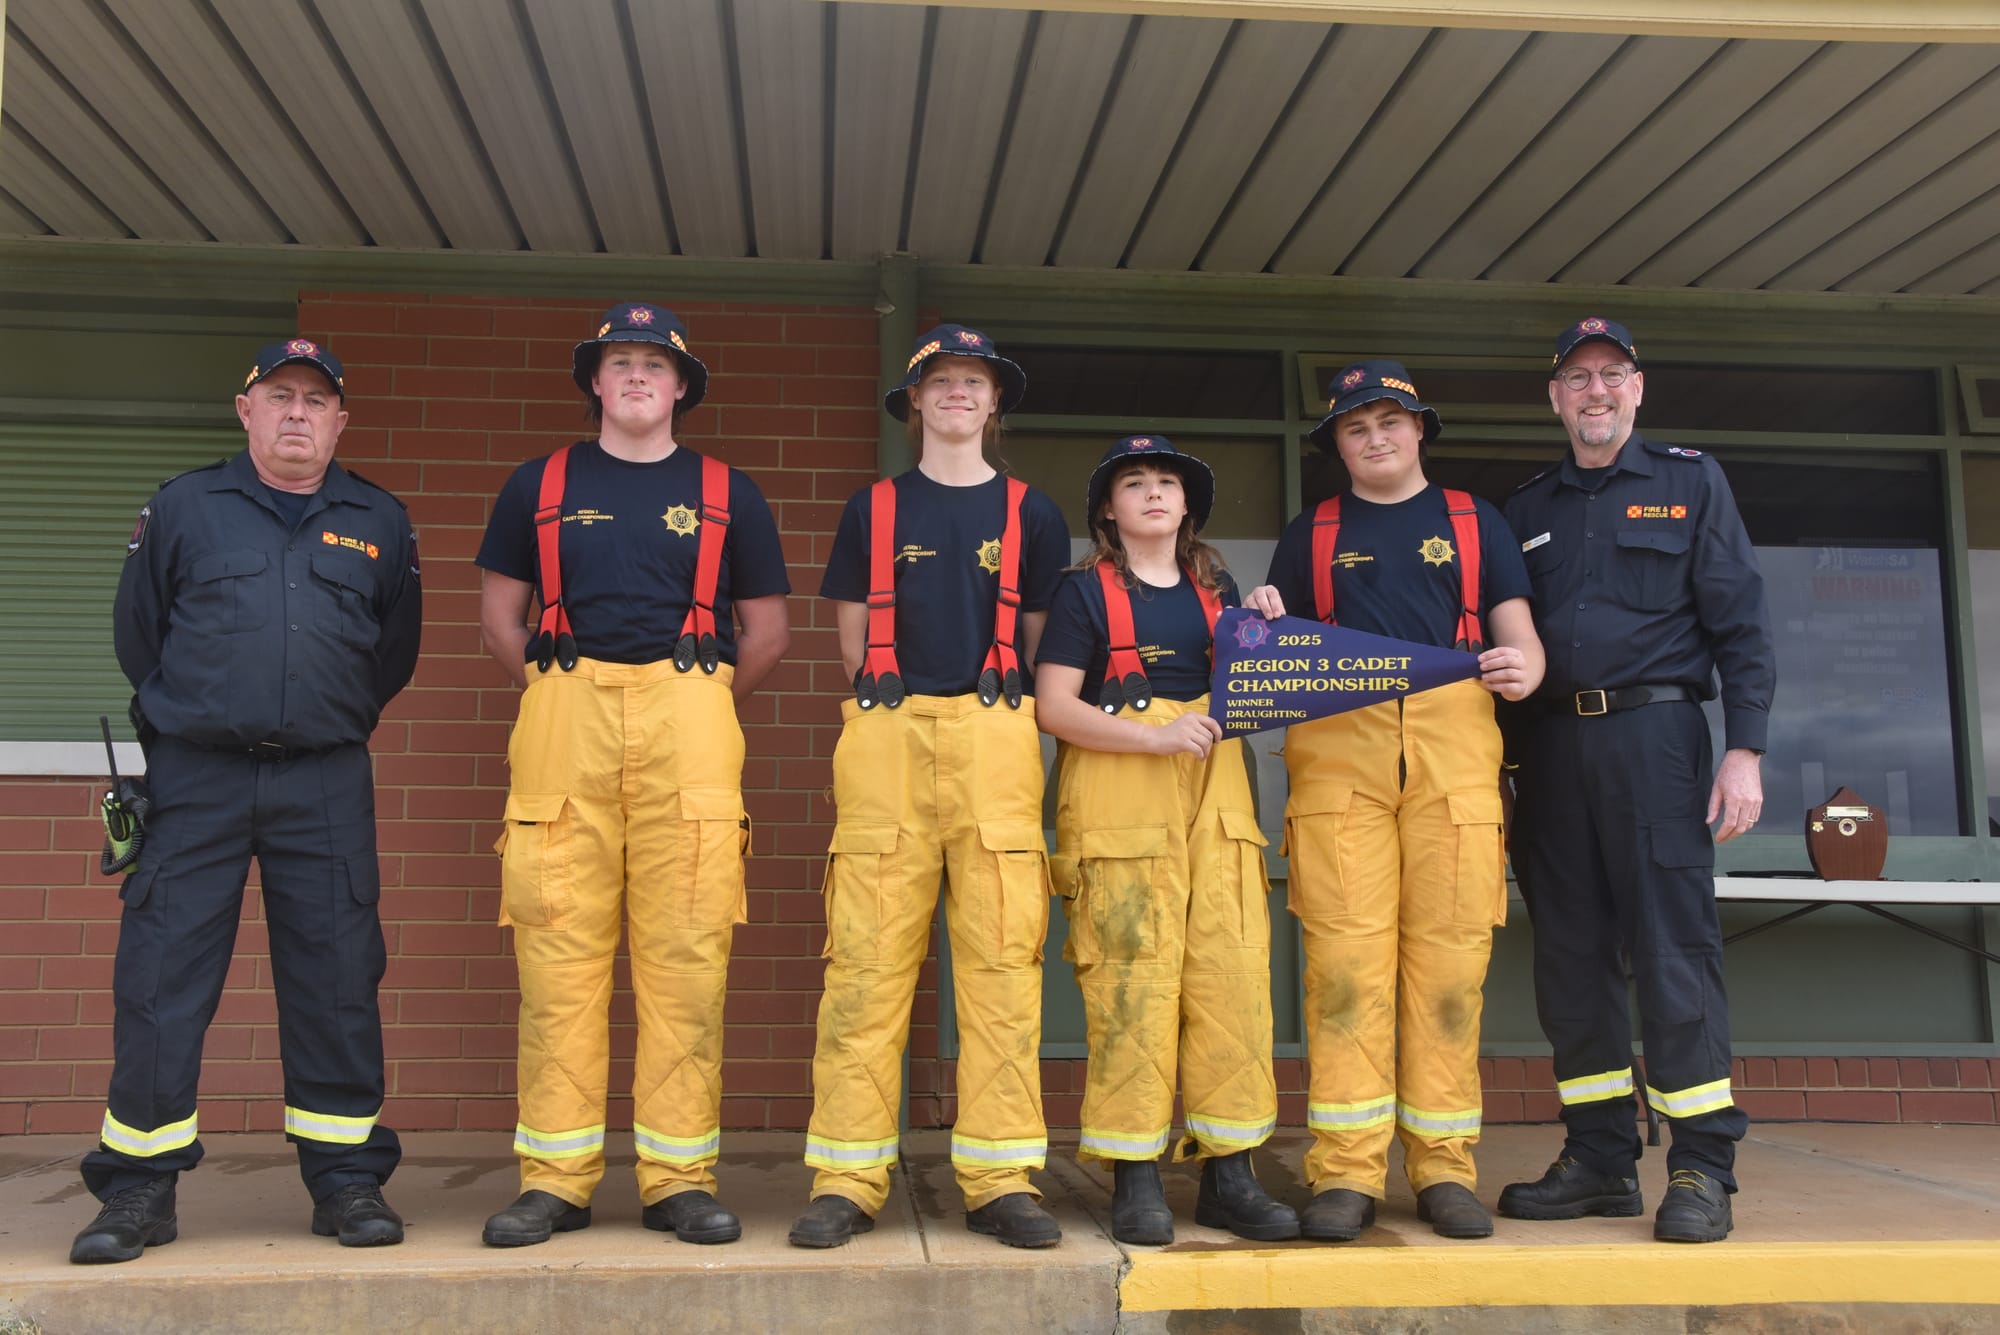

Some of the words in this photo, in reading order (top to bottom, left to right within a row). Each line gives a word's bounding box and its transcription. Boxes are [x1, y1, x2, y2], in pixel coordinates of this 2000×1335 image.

[1277, 634, 1322, 646] 2025
[1229, 658, 1311, 674] REGION
[1316, 658, 1329, 671] 3
[1336, 657, 1412, 671] CADET
[1227, 677, 1411, 693] CHAMPIONSHIPS
[1226, 698, 1275, 708] WINNER
[1225, 710, 1308, 718] DRAUGHTING
[1225, 721, 1261, 729] DRILL
